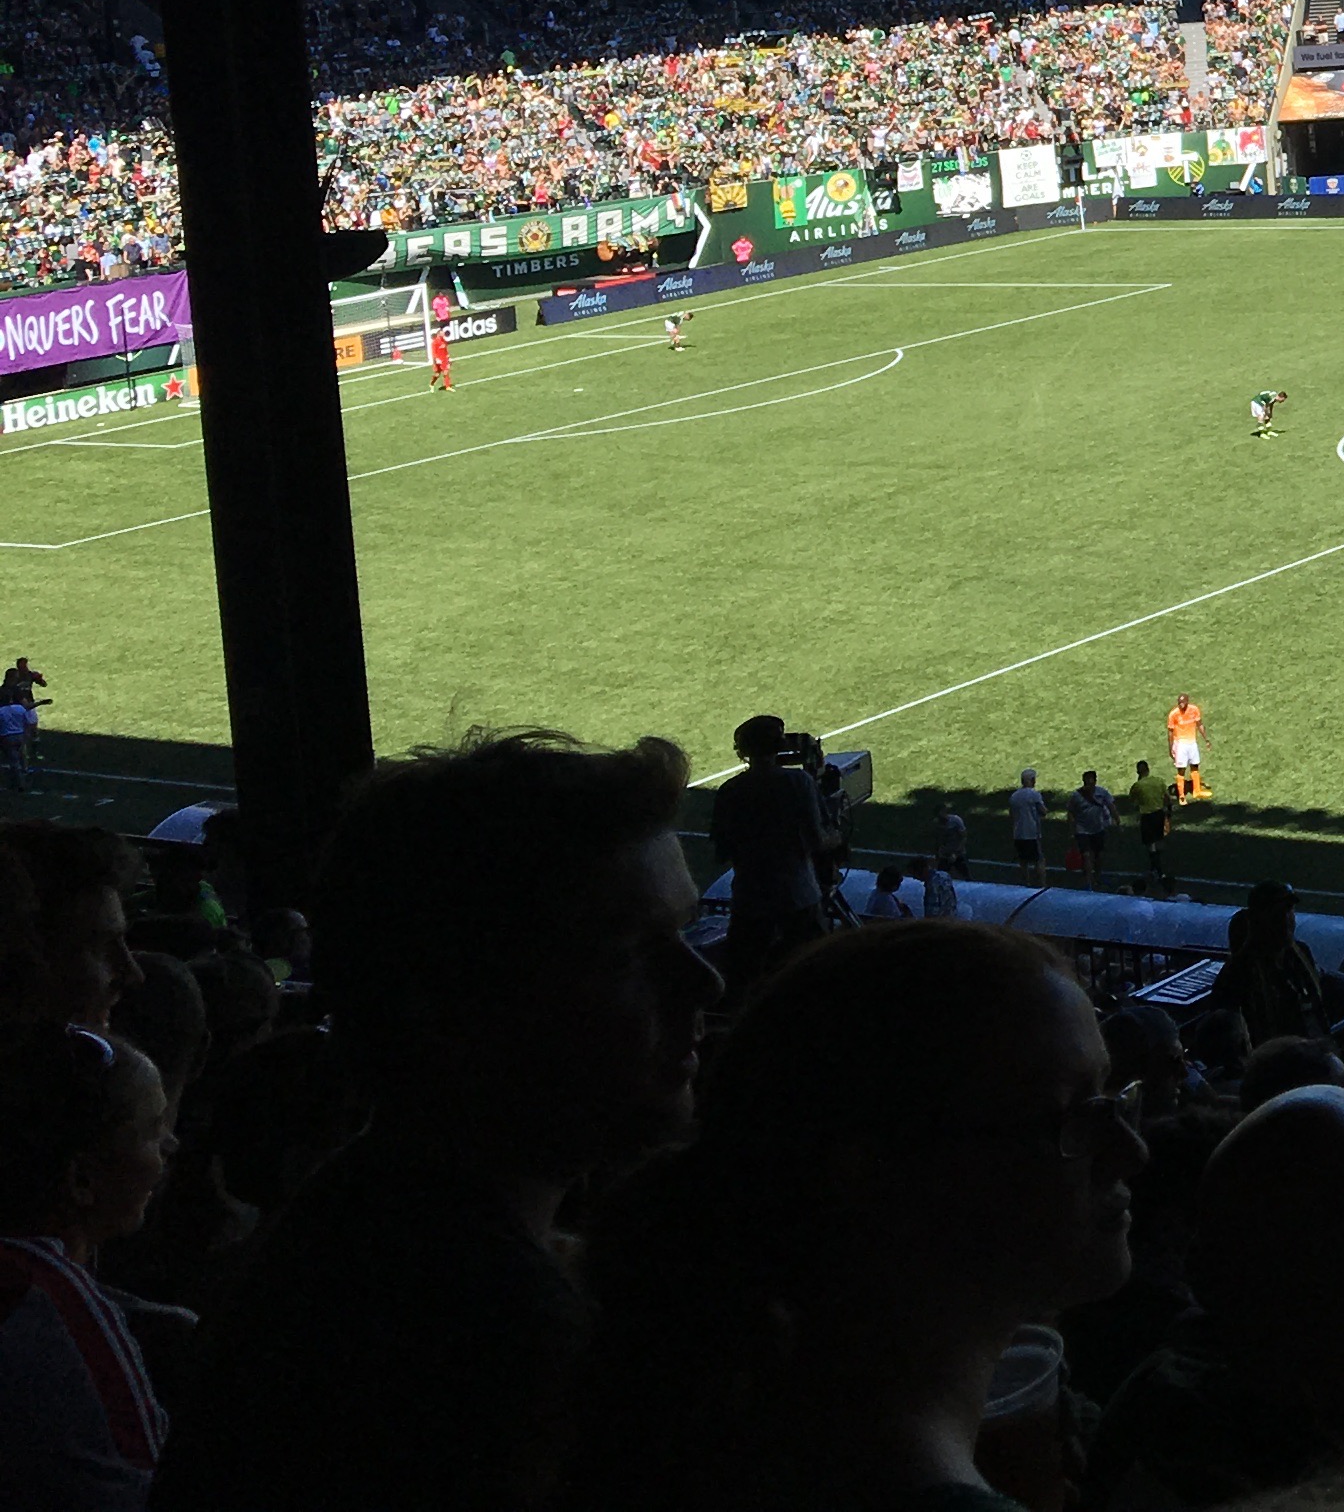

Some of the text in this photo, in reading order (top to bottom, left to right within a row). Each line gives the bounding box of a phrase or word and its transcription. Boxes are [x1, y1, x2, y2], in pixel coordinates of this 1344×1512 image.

[1316, 50, 1334, 61] fuel
[1016, 160, 1039, 171] KEEP
[1015, 170, 1042, 180] CALM
[1020, 182, 1039, 192] ARE
[1014, 191, 1046, 202] GOALS
[1277, 198, 1311, 209] Alaska
[1128, 199, 1161, 213] Alaska
[1201, 198, 1234, 212] Alaska
[966, 216, 997, 232] Alaska
[895, 229, 926, 246] Alaska
[819, 245, 852, 261] Alaska
[492, 253, 581, 279] TIMBERS
[741, 259, 775, 276] Alaska
[657, 275, 694, 292] Alaska
[570, 291, 607, 311] Alaska
[105, 290, 173, 345] FEAR
[3, 383, 158, 434] Heineken
